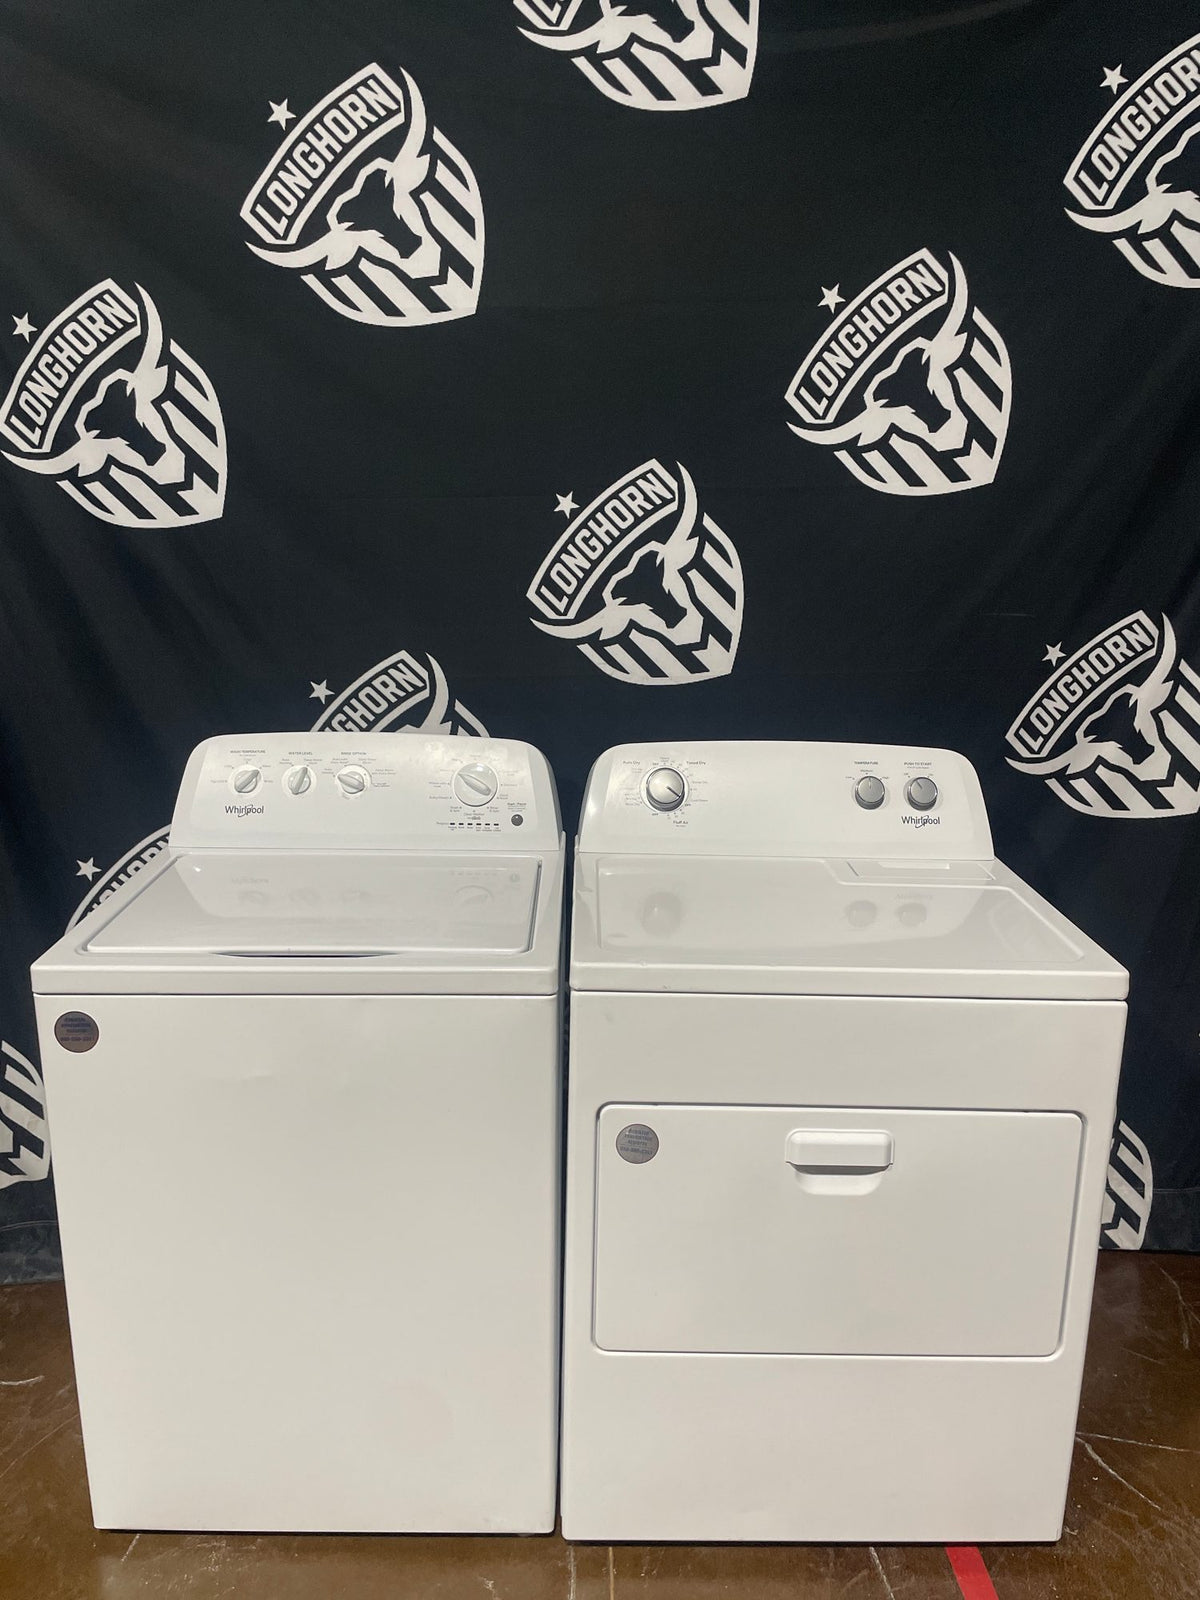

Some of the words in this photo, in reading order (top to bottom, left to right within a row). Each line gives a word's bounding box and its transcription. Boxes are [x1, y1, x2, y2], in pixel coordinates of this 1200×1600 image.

[255, 79, 399, 237] LONGHORN
[1079, 50, 1200, 202] LONGHOR
[10, 294, 135, 446] LONGHORN
[798, 264, 943, 417] LONGHORN
[540, 473, 674, 614] LONGHORN
[1018, 623, 1153, 752] LONGHORN
[224, 804, 265, 818] Whirlpool
[901, 814, 941, 829] Whirlpool
